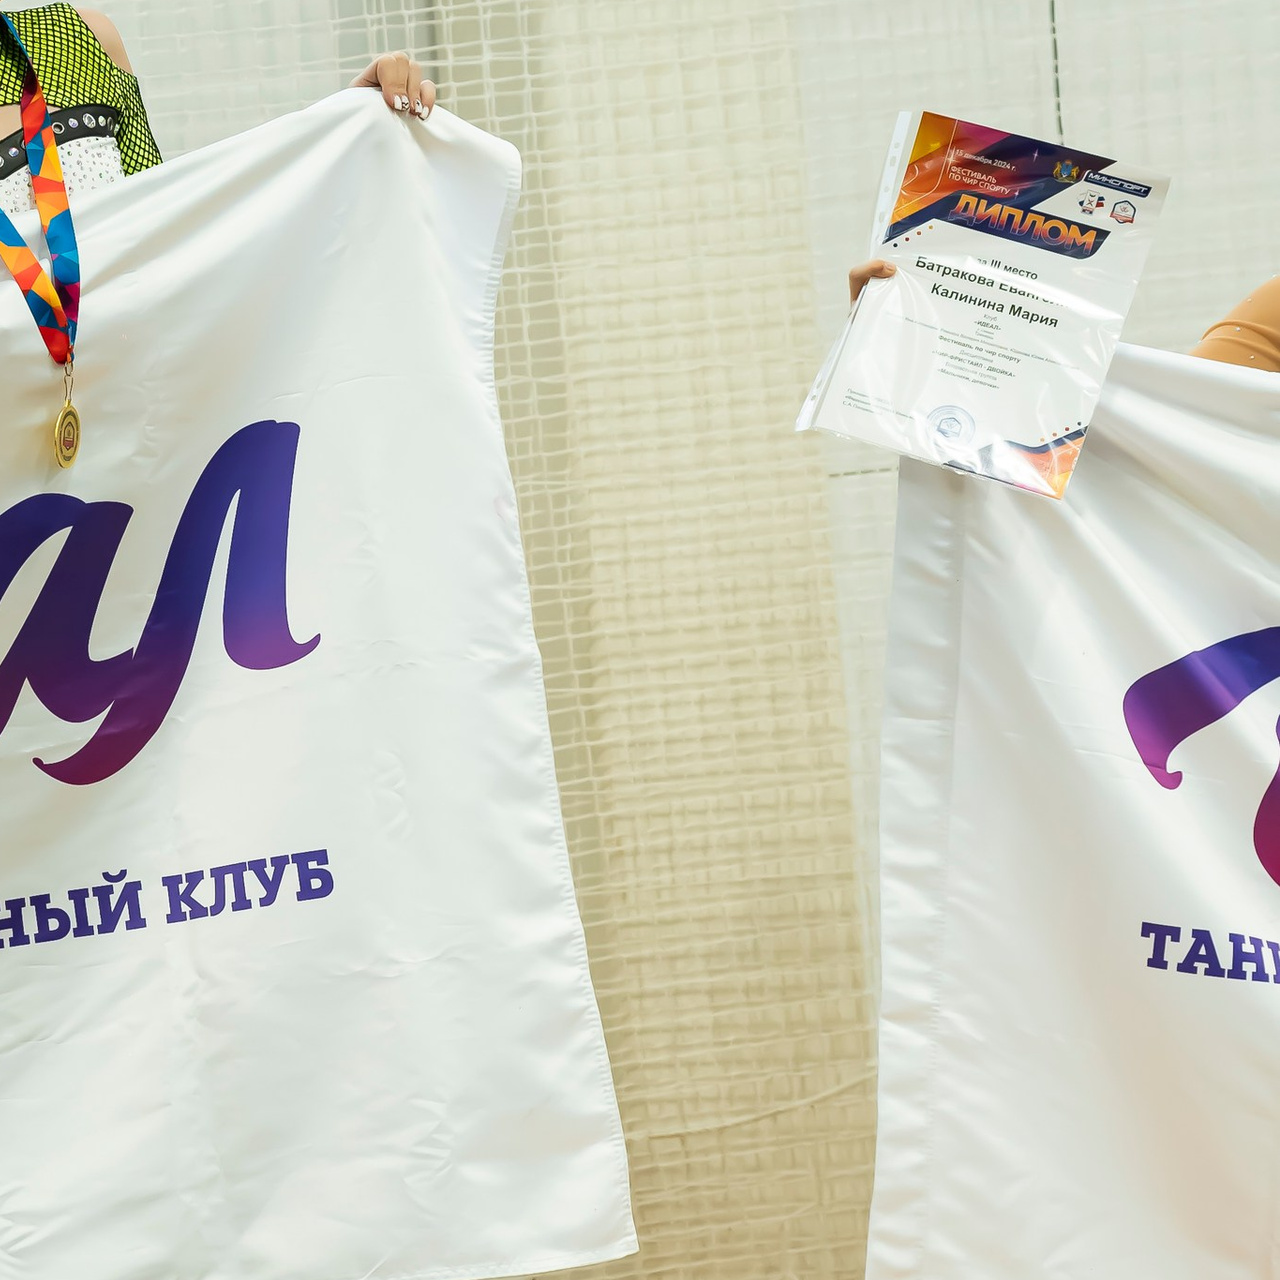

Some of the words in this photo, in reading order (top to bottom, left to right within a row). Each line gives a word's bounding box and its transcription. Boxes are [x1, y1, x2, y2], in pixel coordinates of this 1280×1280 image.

[950, 166, 997, 184] ФЕСТИВАЛЬ
[992, 159, 1012, 170] 2024
[948, 173, 962, 183] ПО
[962, 176, 979, 187] ЧИР
[979, 180, 1012, 195] СПОРТУ
[1087, 173, 1150, 193] МИНСПОРТ
[948, 193, 1098, 256] ДИПЛОМ
[915, 256, 994, 288] Батракова
[990, 258, 1001, 269] III
[1003, 264, 1038, 281] место
[931, 282, 1005, 313] Калинина
[1008, 304, 1059, 328] Мария
[938, 335, 974, 350] Фестиваль
[997, 353, 1021, 364] спорту
[162, 848, 335, 927] КЛУБ
[1140, 921, 1280, 985] ТАН
